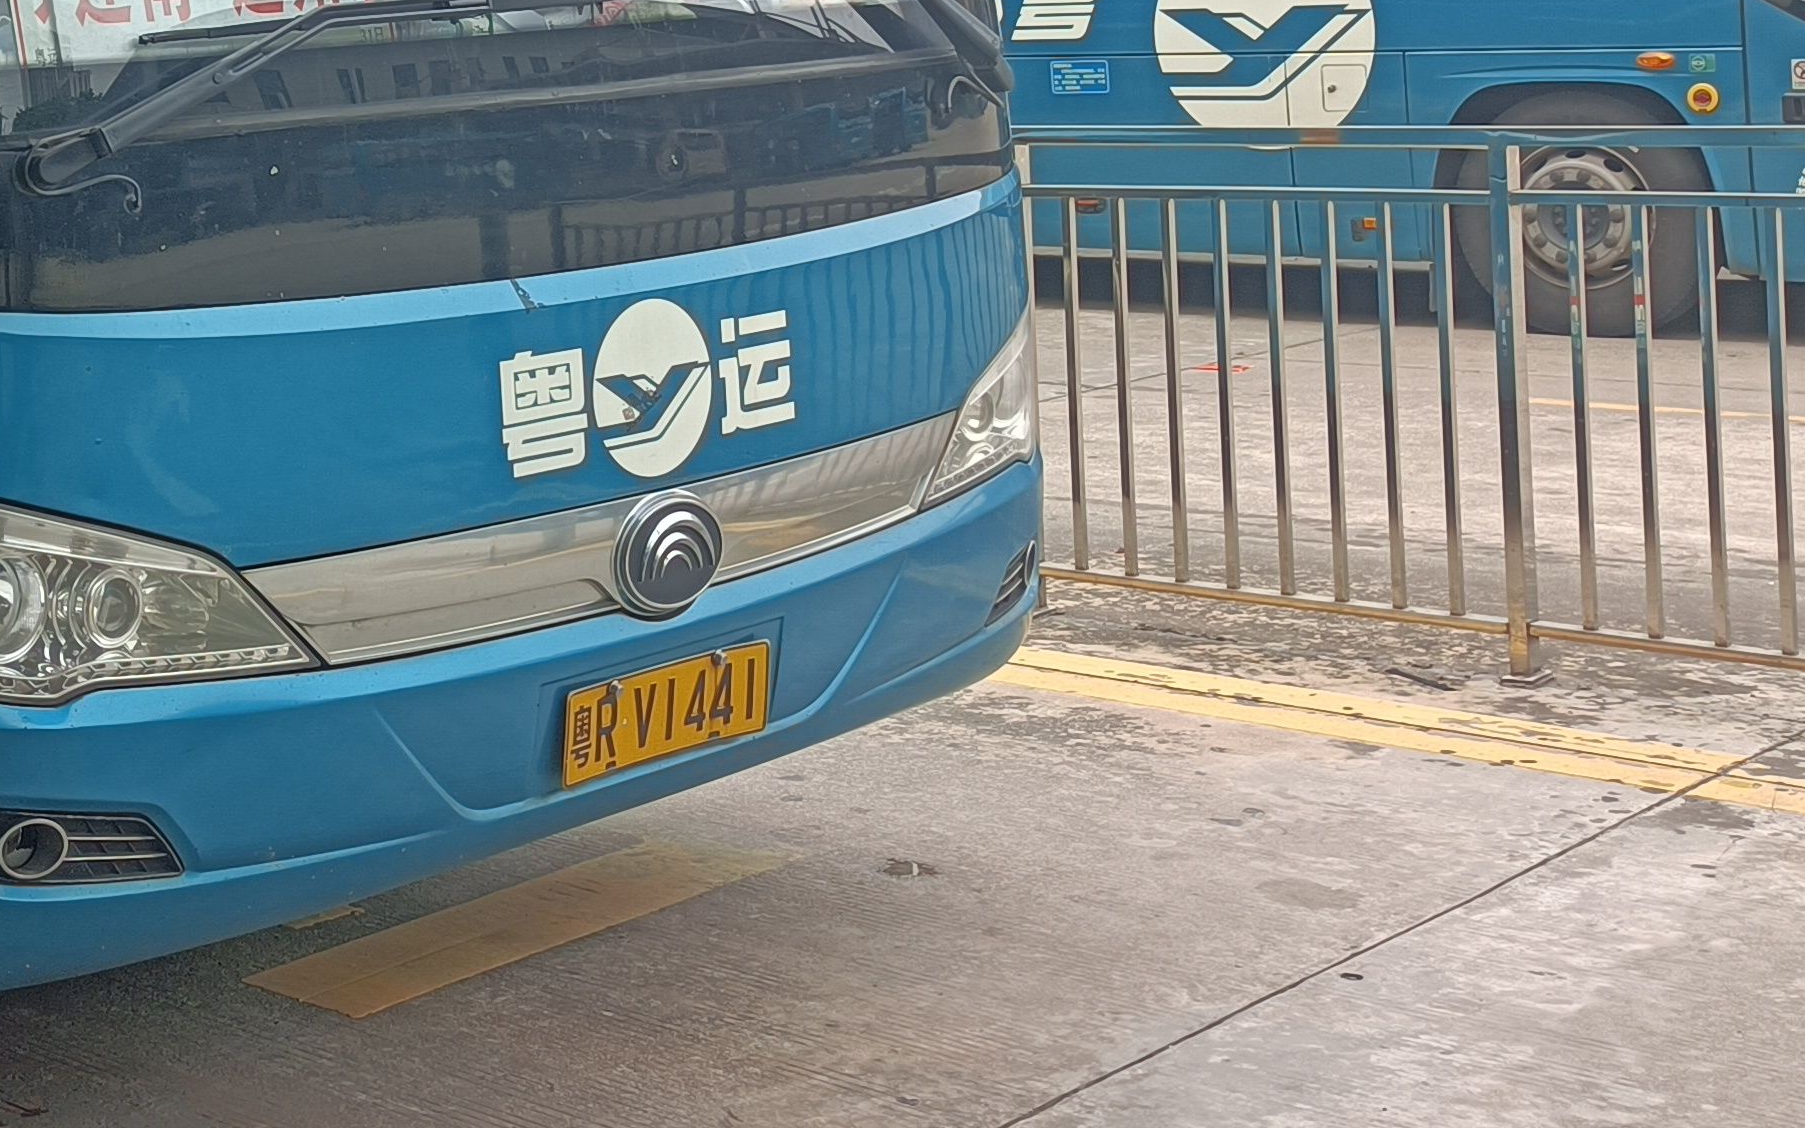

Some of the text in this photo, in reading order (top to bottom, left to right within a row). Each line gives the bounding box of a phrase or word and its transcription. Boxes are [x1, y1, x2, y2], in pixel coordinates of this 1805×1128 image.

[498, 309, 796, 479] 粤 运
[570, 657, 756, 769] 粤RV1441
